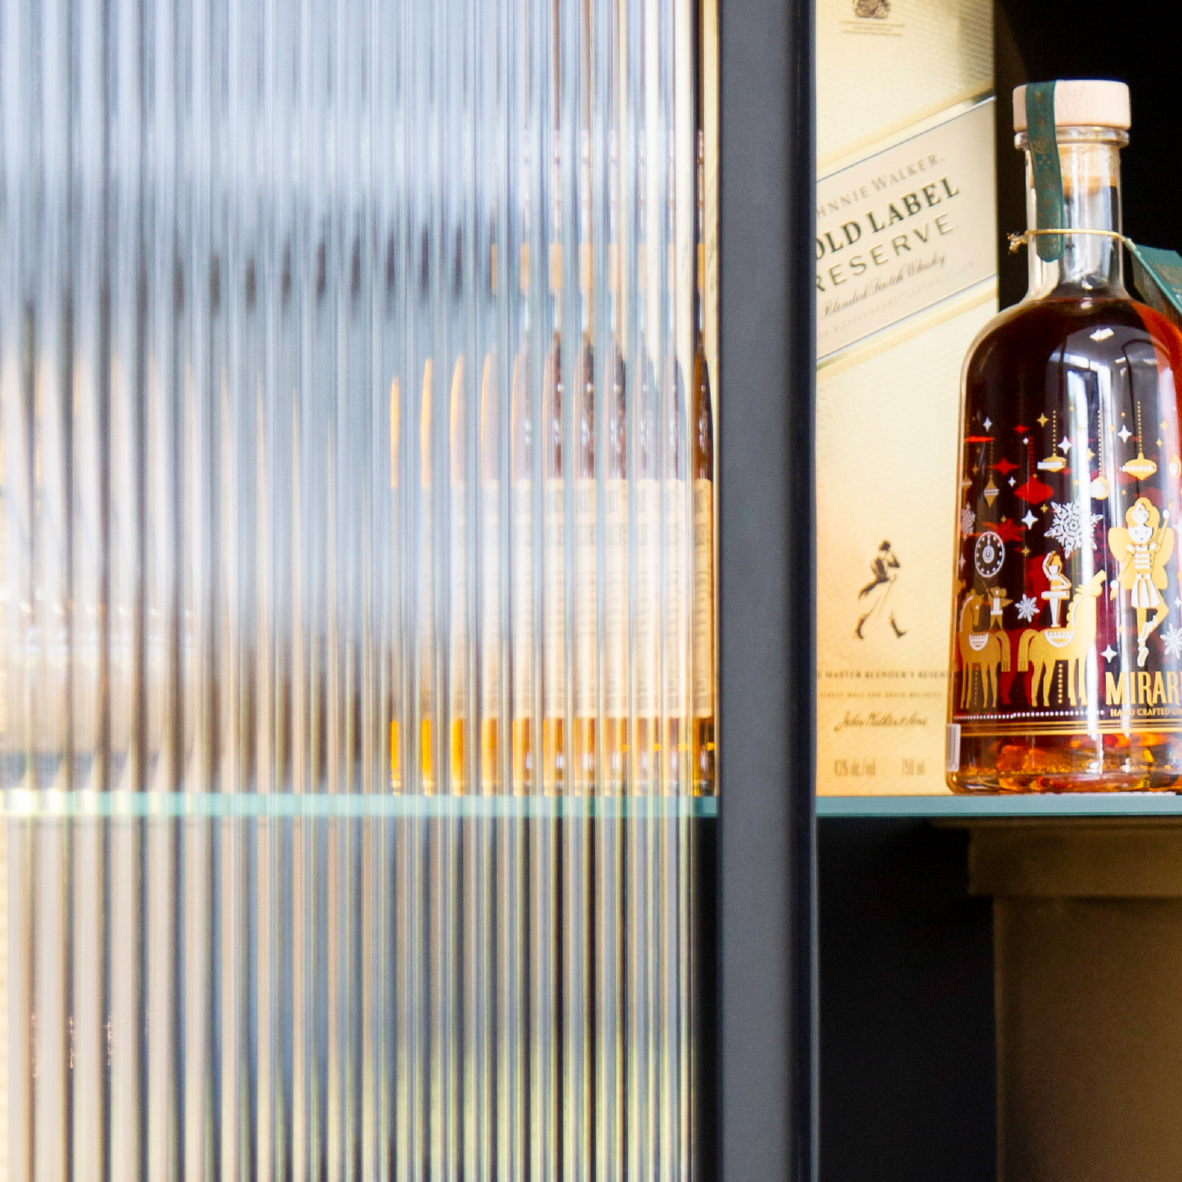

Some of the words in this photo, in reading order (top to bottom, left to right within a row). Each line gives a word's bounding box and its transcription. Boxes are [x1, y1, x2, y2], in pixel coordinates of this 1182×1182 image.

[816, 185, 870, 219] HNNIE
[816, 220, 862, 260] OLD
[866, 176, 959, 233] LABEL
[821, 284, 868, 318] Blended
[904, 251, 946, 277] Whisky
[1137, 707, 1171, 717] CRAFTED
